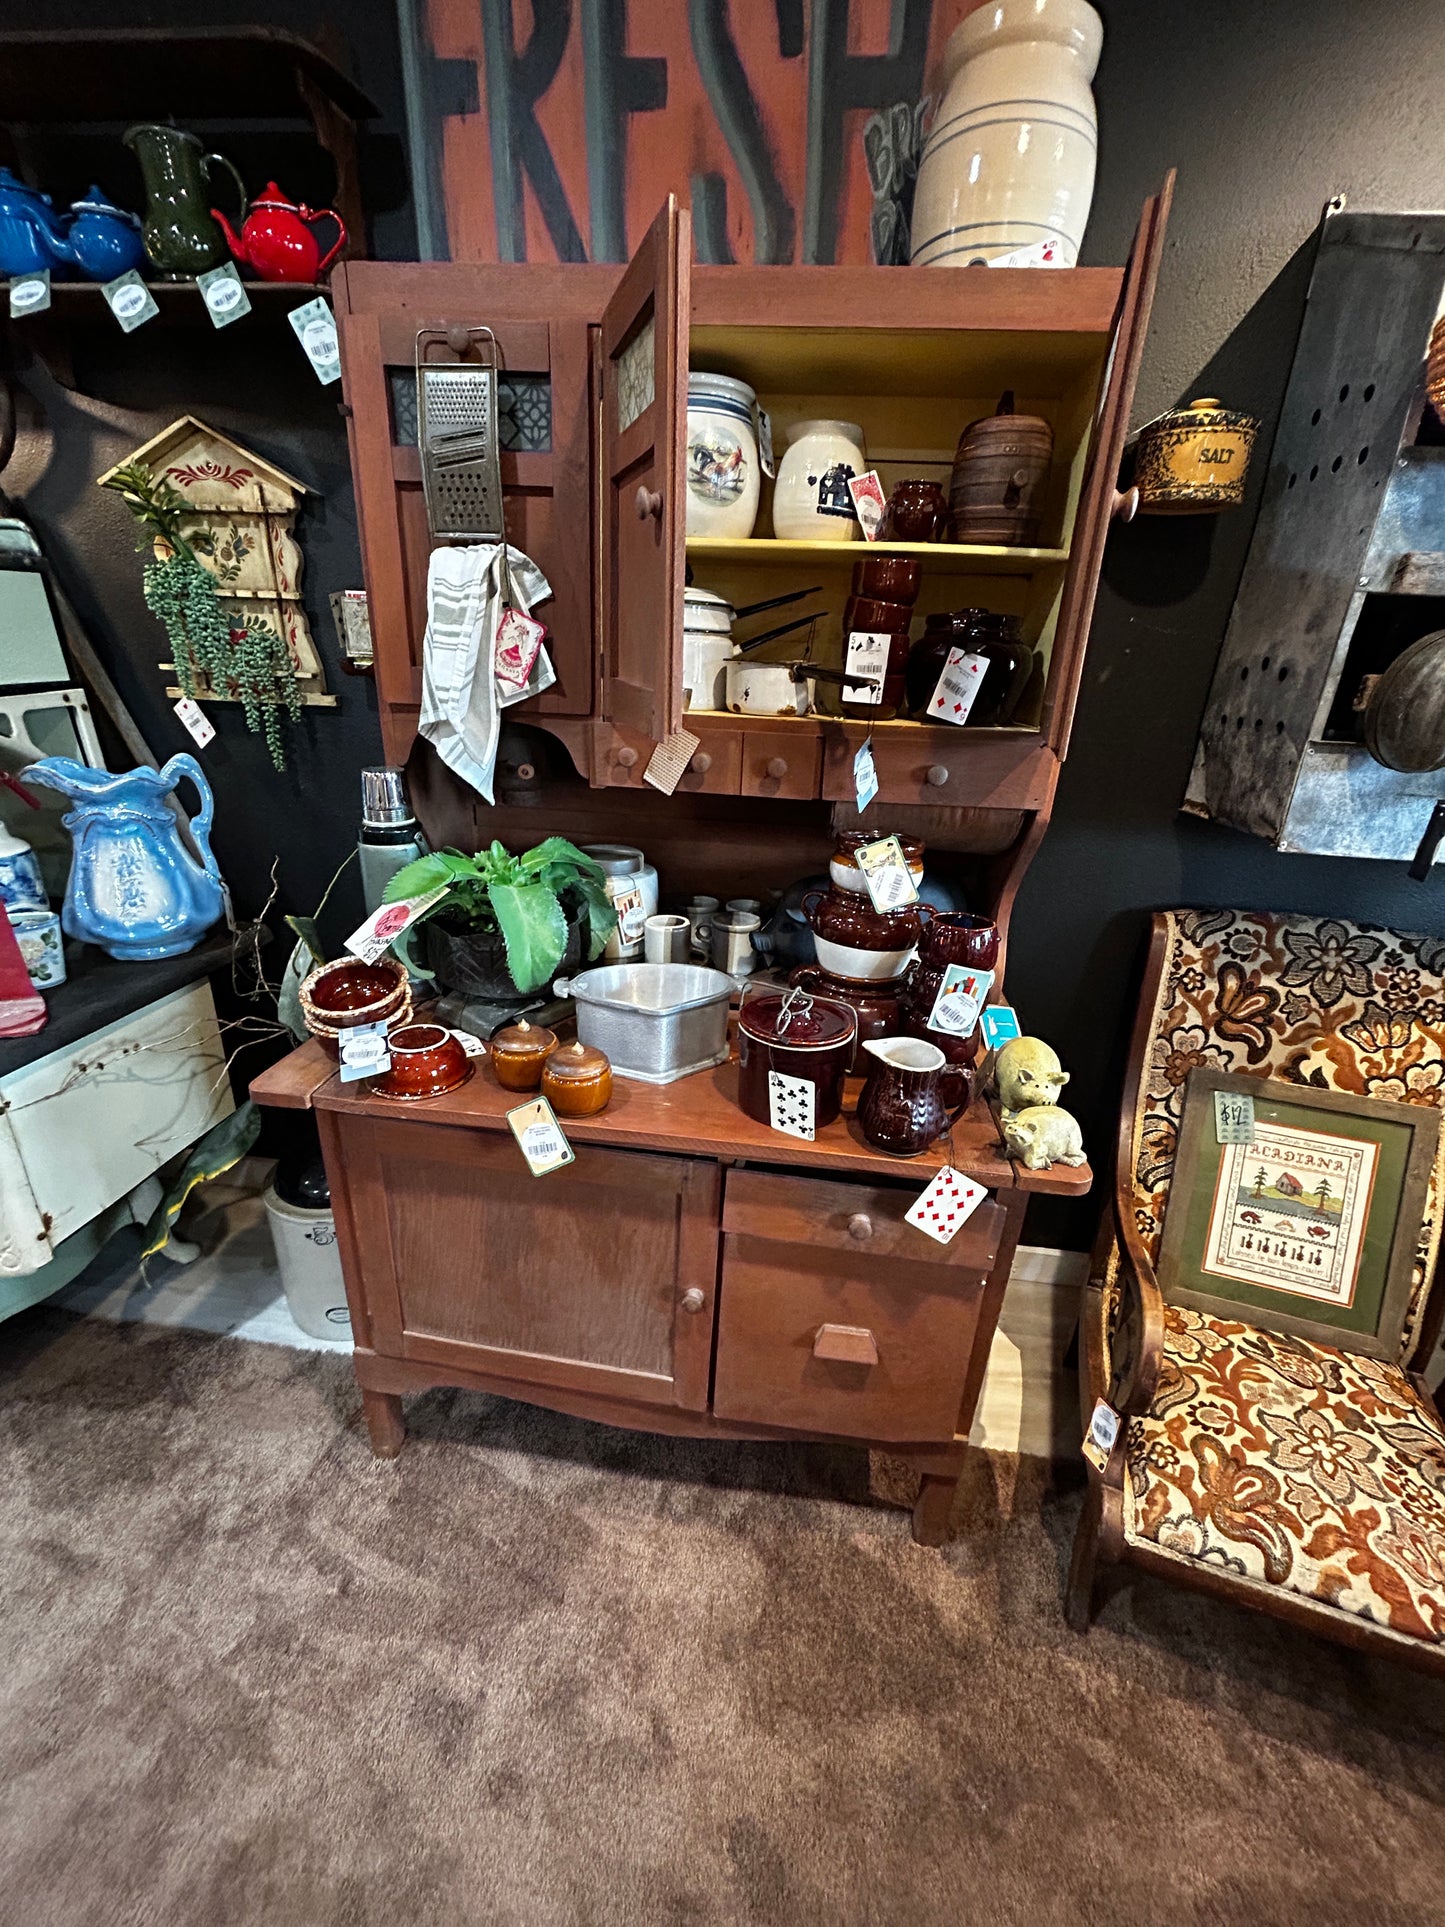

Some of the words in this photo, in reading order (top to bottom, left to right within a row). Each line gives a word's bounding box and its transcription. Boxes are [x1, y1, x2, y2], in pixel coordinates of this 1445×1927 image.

[1200, 448, 1235, 464] SALT
[1221, 1103, 1247, 1126] $12
[1249, 1143, 1346, 1172] ACADIANA
